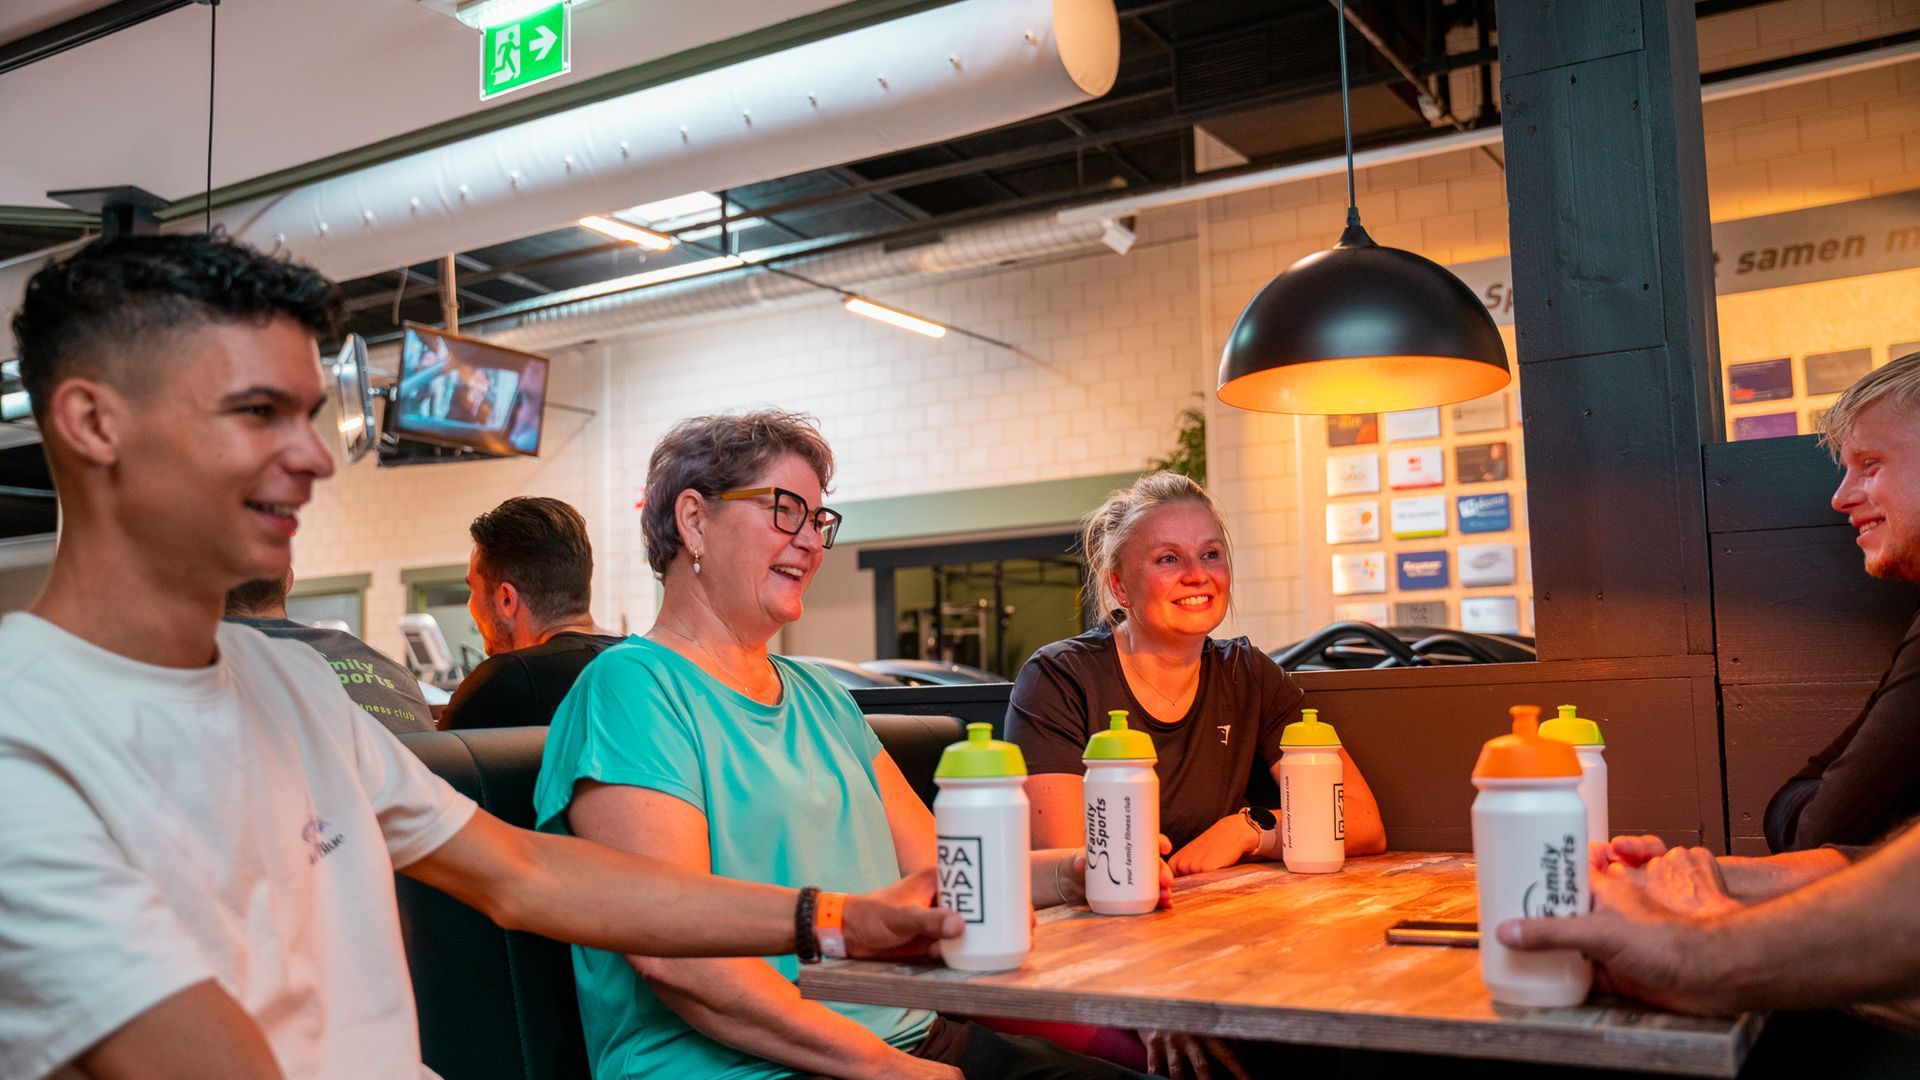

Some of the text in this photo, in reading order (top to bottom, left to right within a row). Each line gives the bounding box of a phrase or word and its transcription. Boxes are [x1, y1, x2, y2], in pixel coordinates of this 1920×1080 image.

[1736, 232, 1867, 276] samen
[329, 658, 374, 675] mily
[337, 672, 395, 690] ports
[361, 703, 416, 721] ness club
[1087, 803, 1097, 856] Family
[1097, 797, 1109, 848] Sports
[1124, 815, 1132, 840] fitness
[937, 845, 973, 866] RA
[1124, 842, 1133, 867] family
[938, 868, 974, 890] VA
[1126, 867, 1134, 886] your
[1562, 835, 1578, 906] Sports
